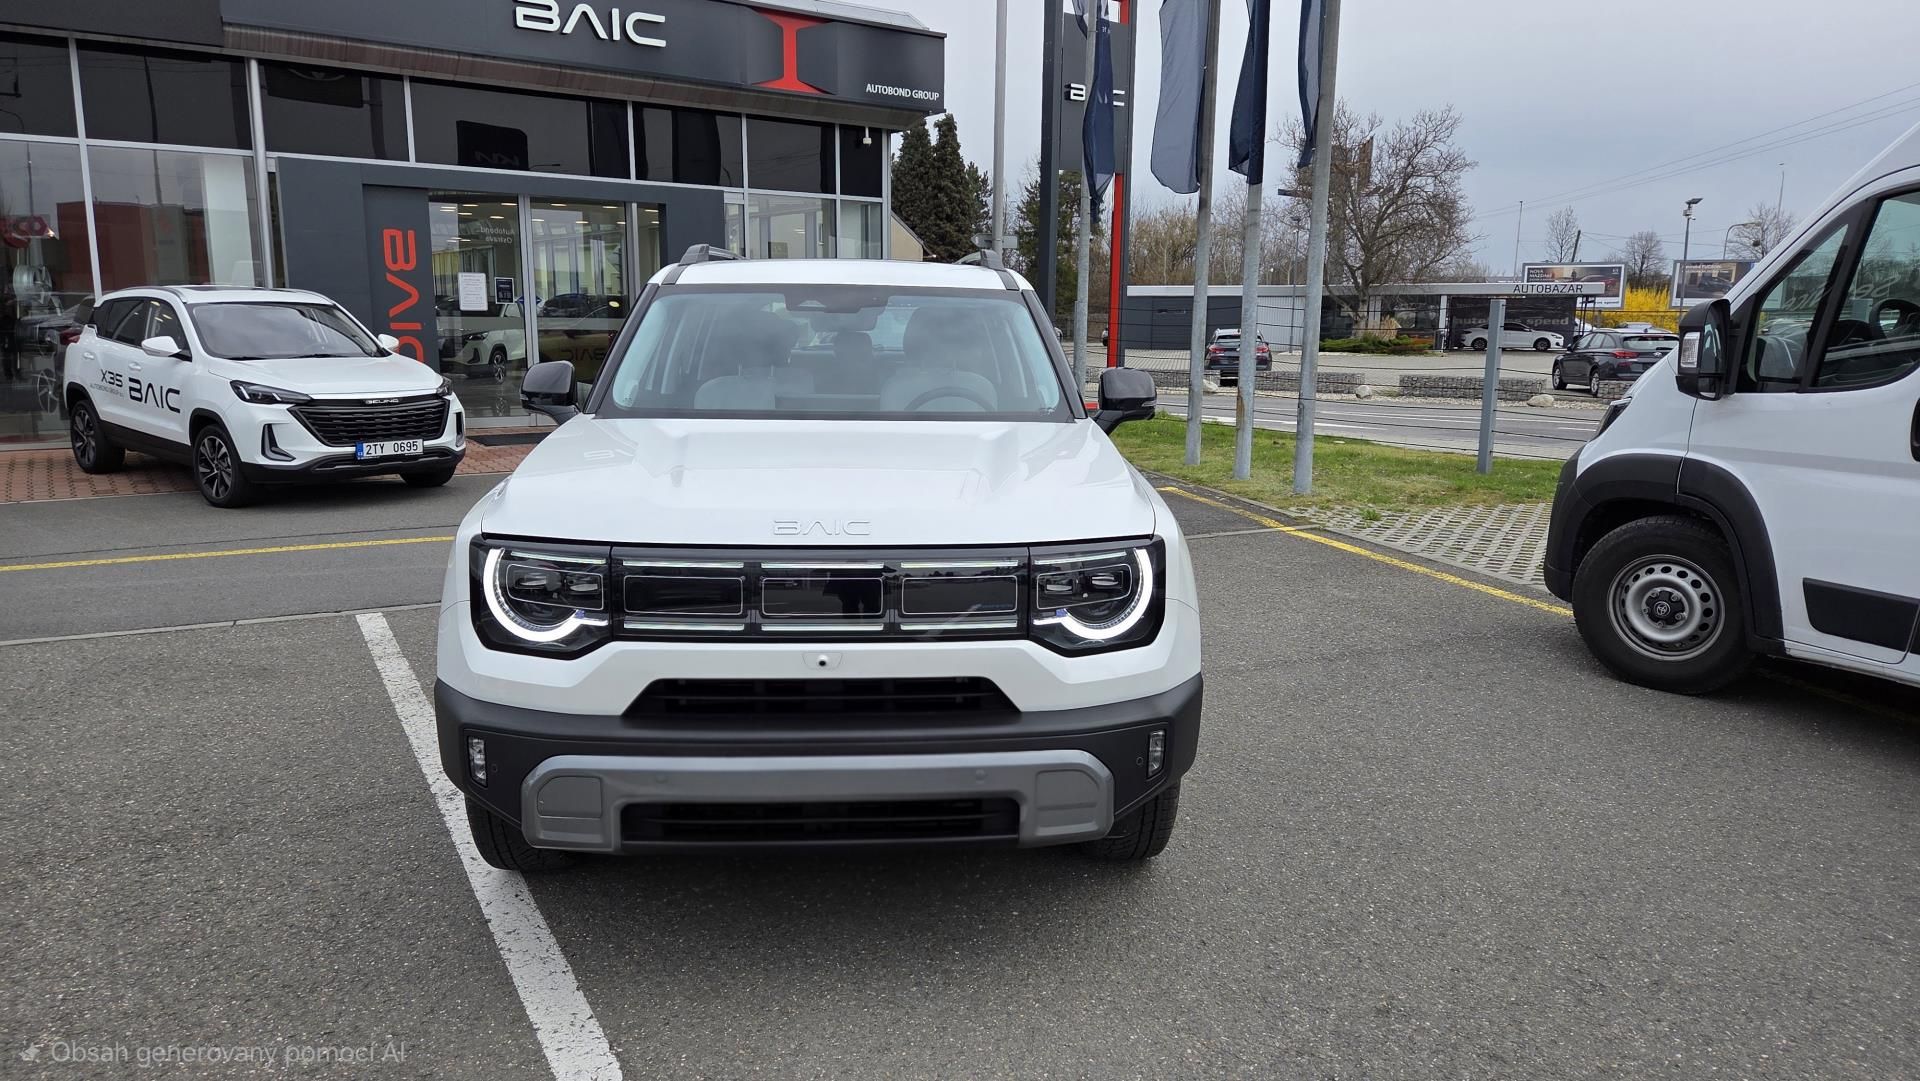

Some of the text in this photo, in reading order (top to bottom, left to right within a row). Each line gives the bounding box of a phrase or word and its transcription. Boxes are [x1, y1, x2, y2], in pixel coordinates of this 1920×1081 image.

[515, 0, 667, 48] BAIC
[865, 83, 940, 101] AUTOBOND GROUP
[1513, 284, 1583, 294] AUTOBAZAR
[1526, 317, 1569, 326] speed
[101, 369, 123, 388] X35
[128, 377, 180, 413] BAIC
[366, 443, 385, 455] 2TY
[393, 441, 418, 453] 0695
[773, 519, 871, 535] BAIC
